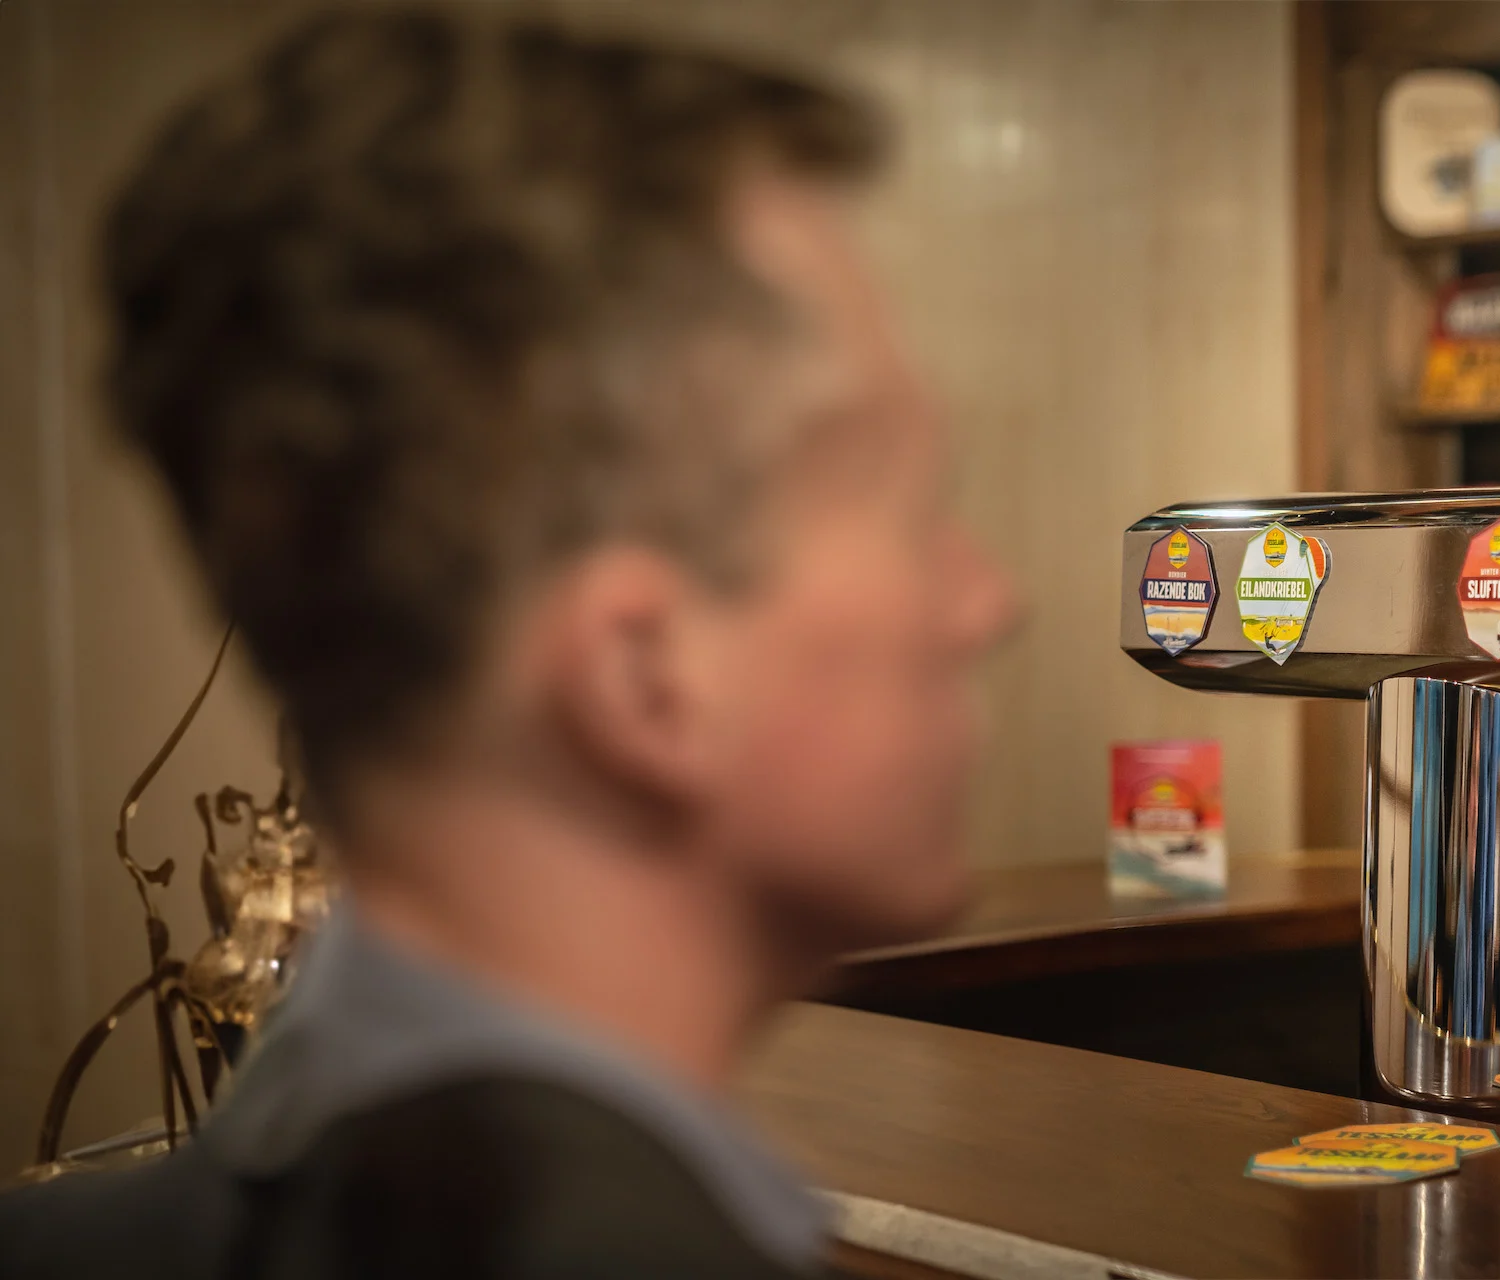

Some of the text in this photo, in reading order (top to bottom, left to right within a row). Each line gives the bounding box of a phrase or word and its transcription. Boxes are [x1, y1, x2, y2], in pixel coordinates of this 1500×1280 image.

[1147, 580, 1206, 601] RAZENDE BOK
[1240, 580, 1307, 599] EILANDKRIEBEL
[1336, 1130, 1486, 1143] TESSELAAR
[1296, 1147, 1447, 1162] TESSELAAR
